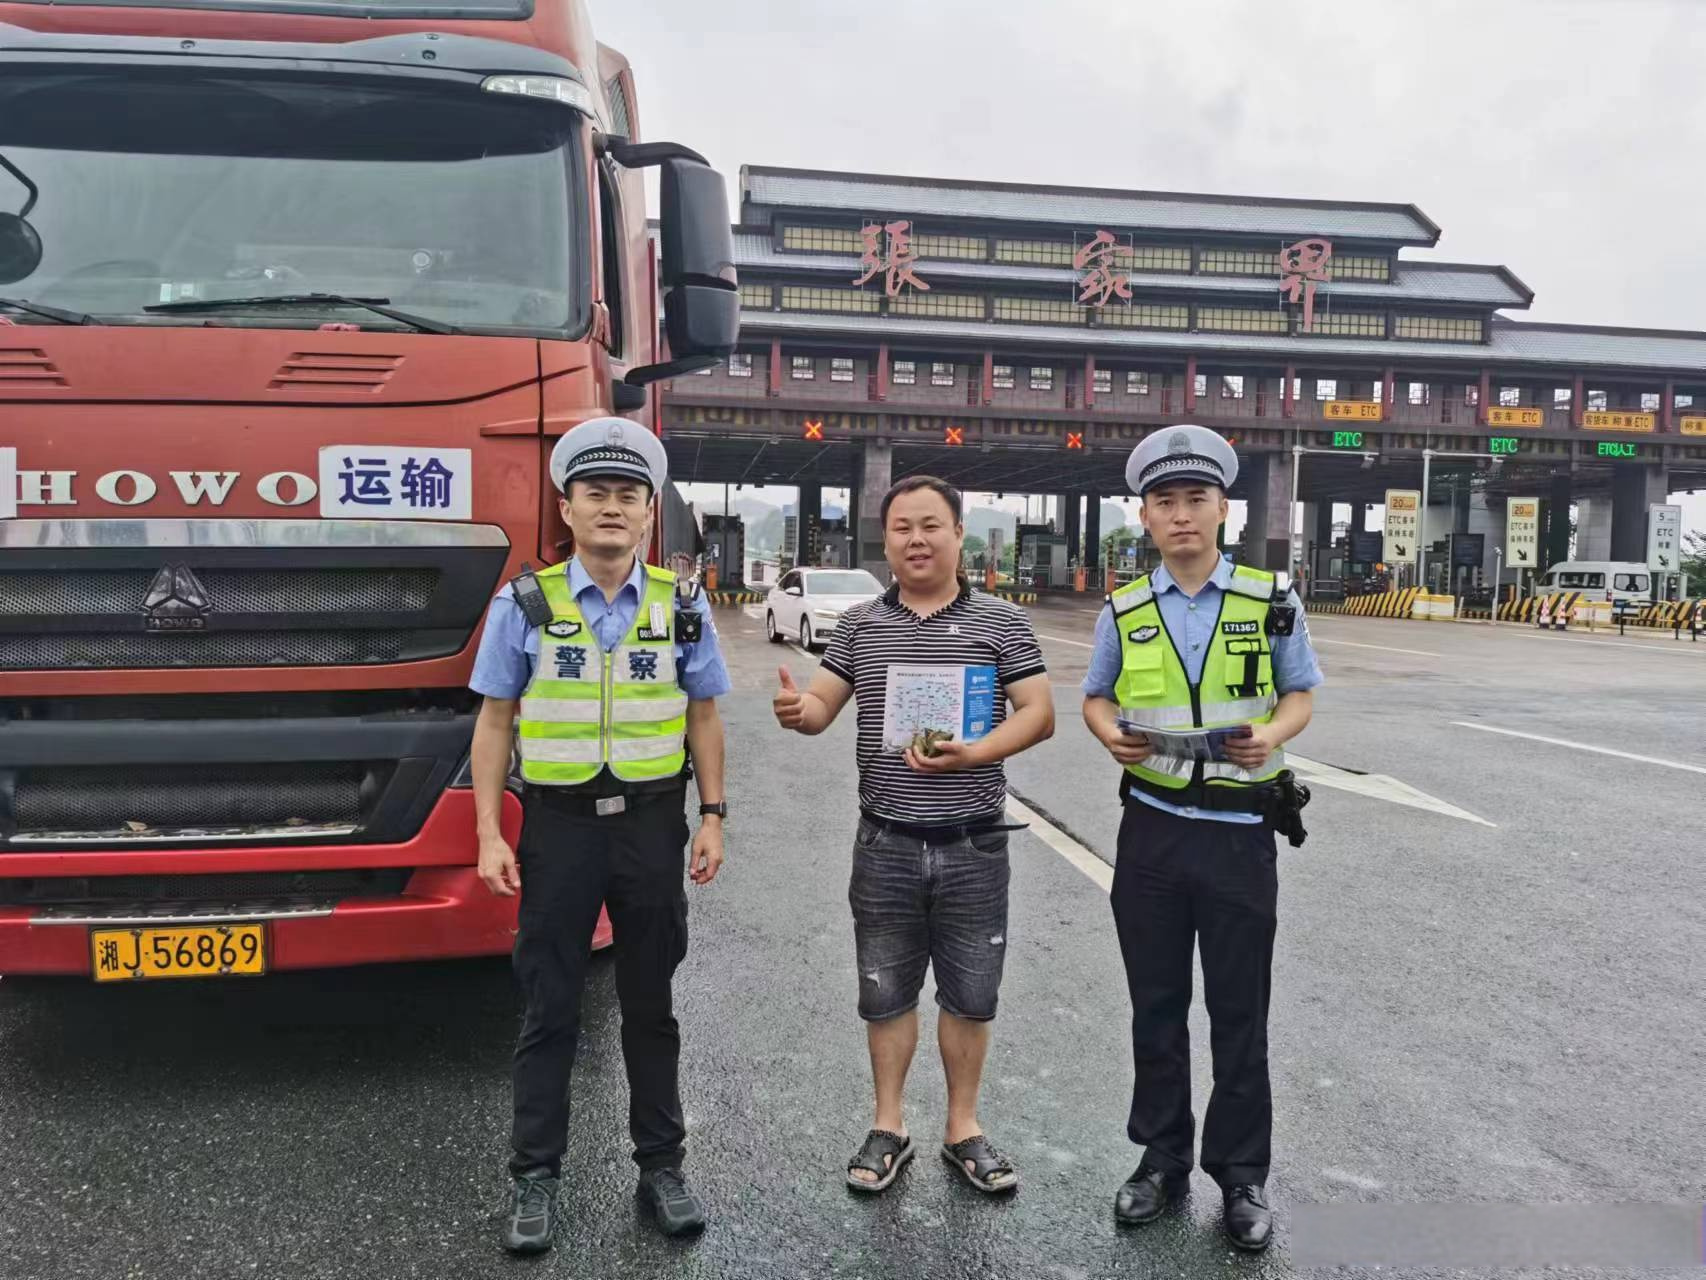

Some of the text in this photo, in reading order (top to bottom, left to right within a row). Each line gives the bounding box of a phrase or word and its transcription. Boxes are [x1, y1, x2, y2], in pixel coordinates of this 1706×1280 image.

[1330, 403, 1377, 417] 客车 ETC
[1492, 411, 1538, 424] 客车 ETC
[1333, 431, 1362, 447] ETC
[1490, 438, 1518, 453] ETC
[16, 470, 318, 506] HOWO
[338, 457, 454, 508] 运输
[1392, 498, 1403, 508] 20
[1659, 512, 1665, 521] 5
[1656, 528, 1673, 537] ETC
[1224, 623, 1257, 633] 171362
[554, 645, 658, 680] 警察
